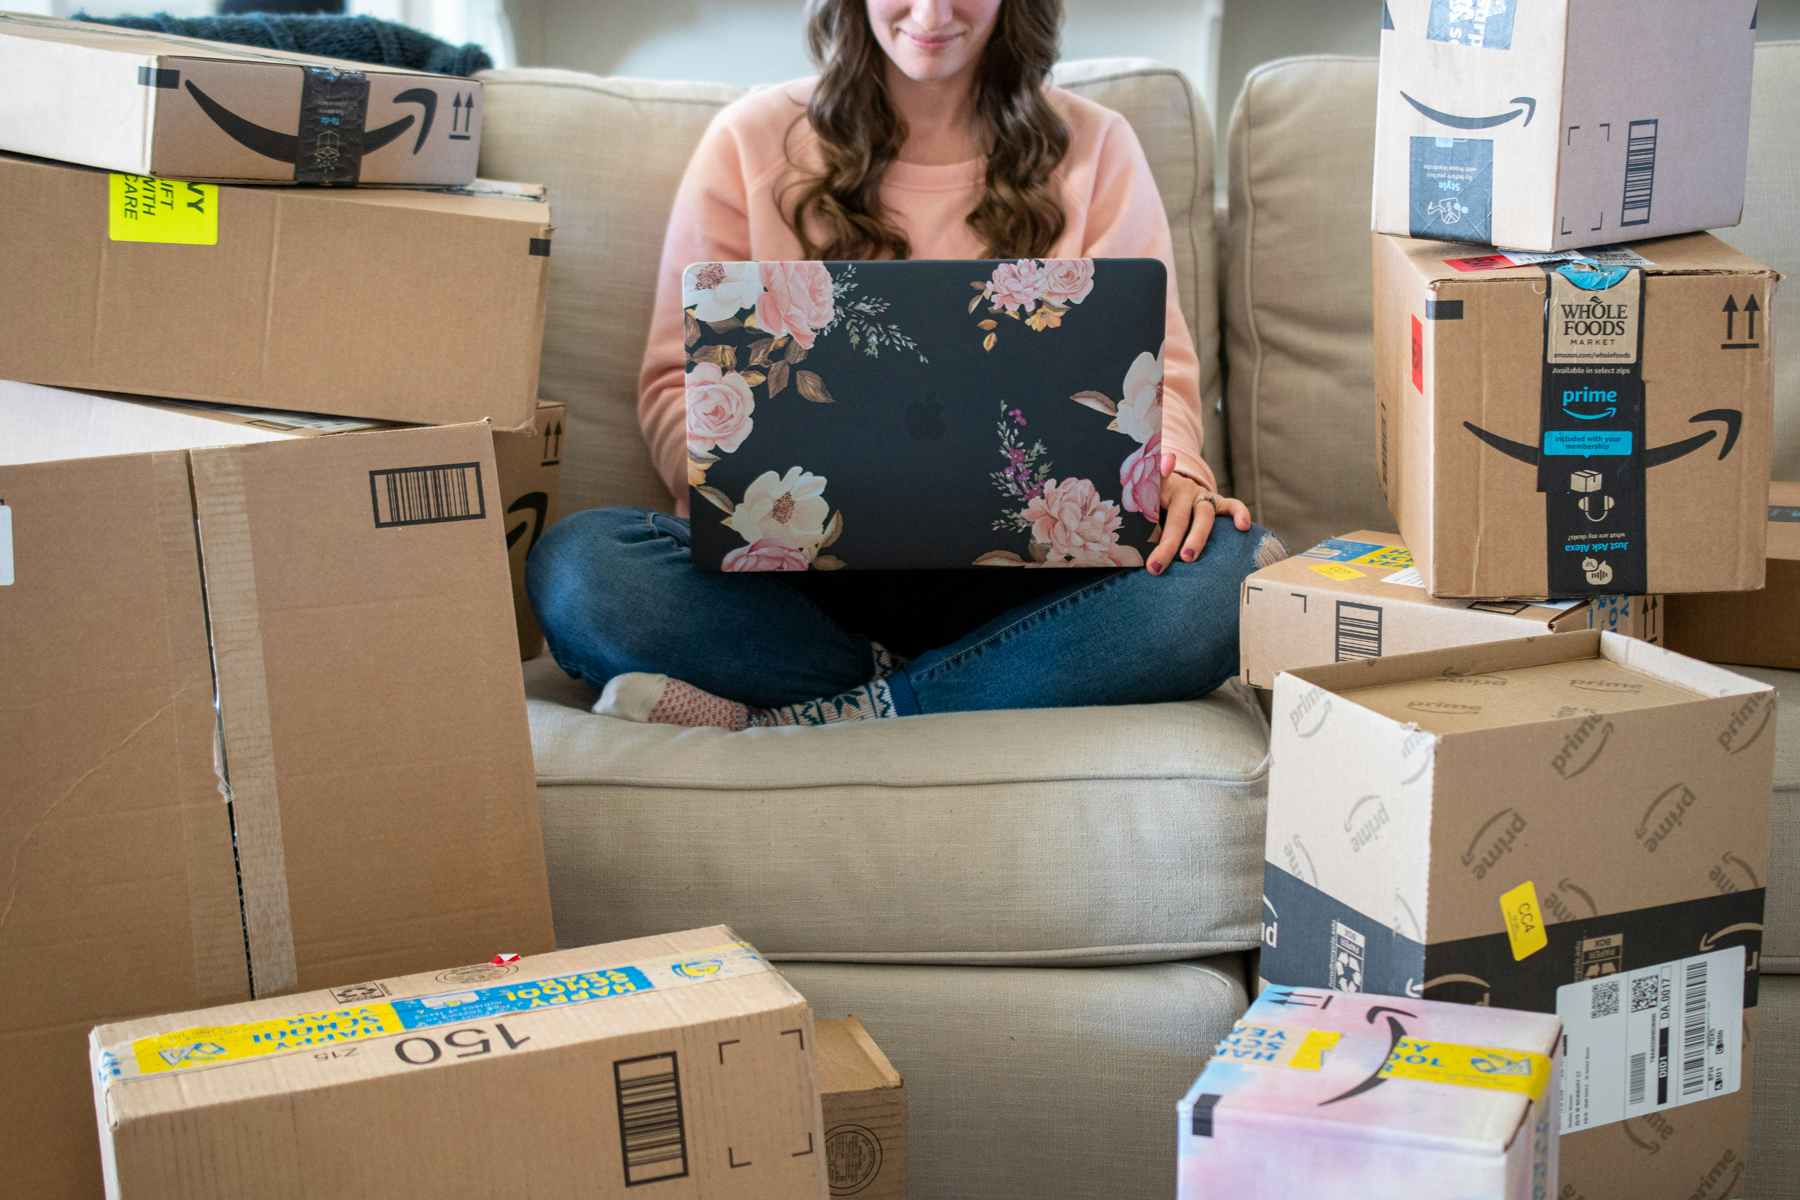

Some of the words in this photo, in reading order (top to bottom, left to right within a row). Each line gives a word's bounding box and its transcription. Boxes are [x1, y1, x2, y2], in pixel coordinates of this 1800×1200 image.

[124, 174, 138, 221] CARE
[160, 180, 174, 210] IFT
[1561, 303, 1628, 320] WHOLE
[1563, 320, 1625, 336] FOODS
[1562, 386, 1617, 406] prime
[1564, 544, 1590, 553] Alexa
[1591, 543, 1609, 552] Ask
[1610, 542, 1629, 551] Just
[1350, 801, 1390, 853] prime
[1646, 786, 1697, 853] prime
[1473, 811, 1527, 881] prime
[506, 970, 630, 1001] SCHOOL
[530, 982, 637, 1009] HAPPY
[252, 1015, 380, 1044] SCHOOL
[288, 1008, 369, 1026] YEAR
[276, 1025, 385, 1050] HAPPY
[394, 1022, 531, 1065] 150
